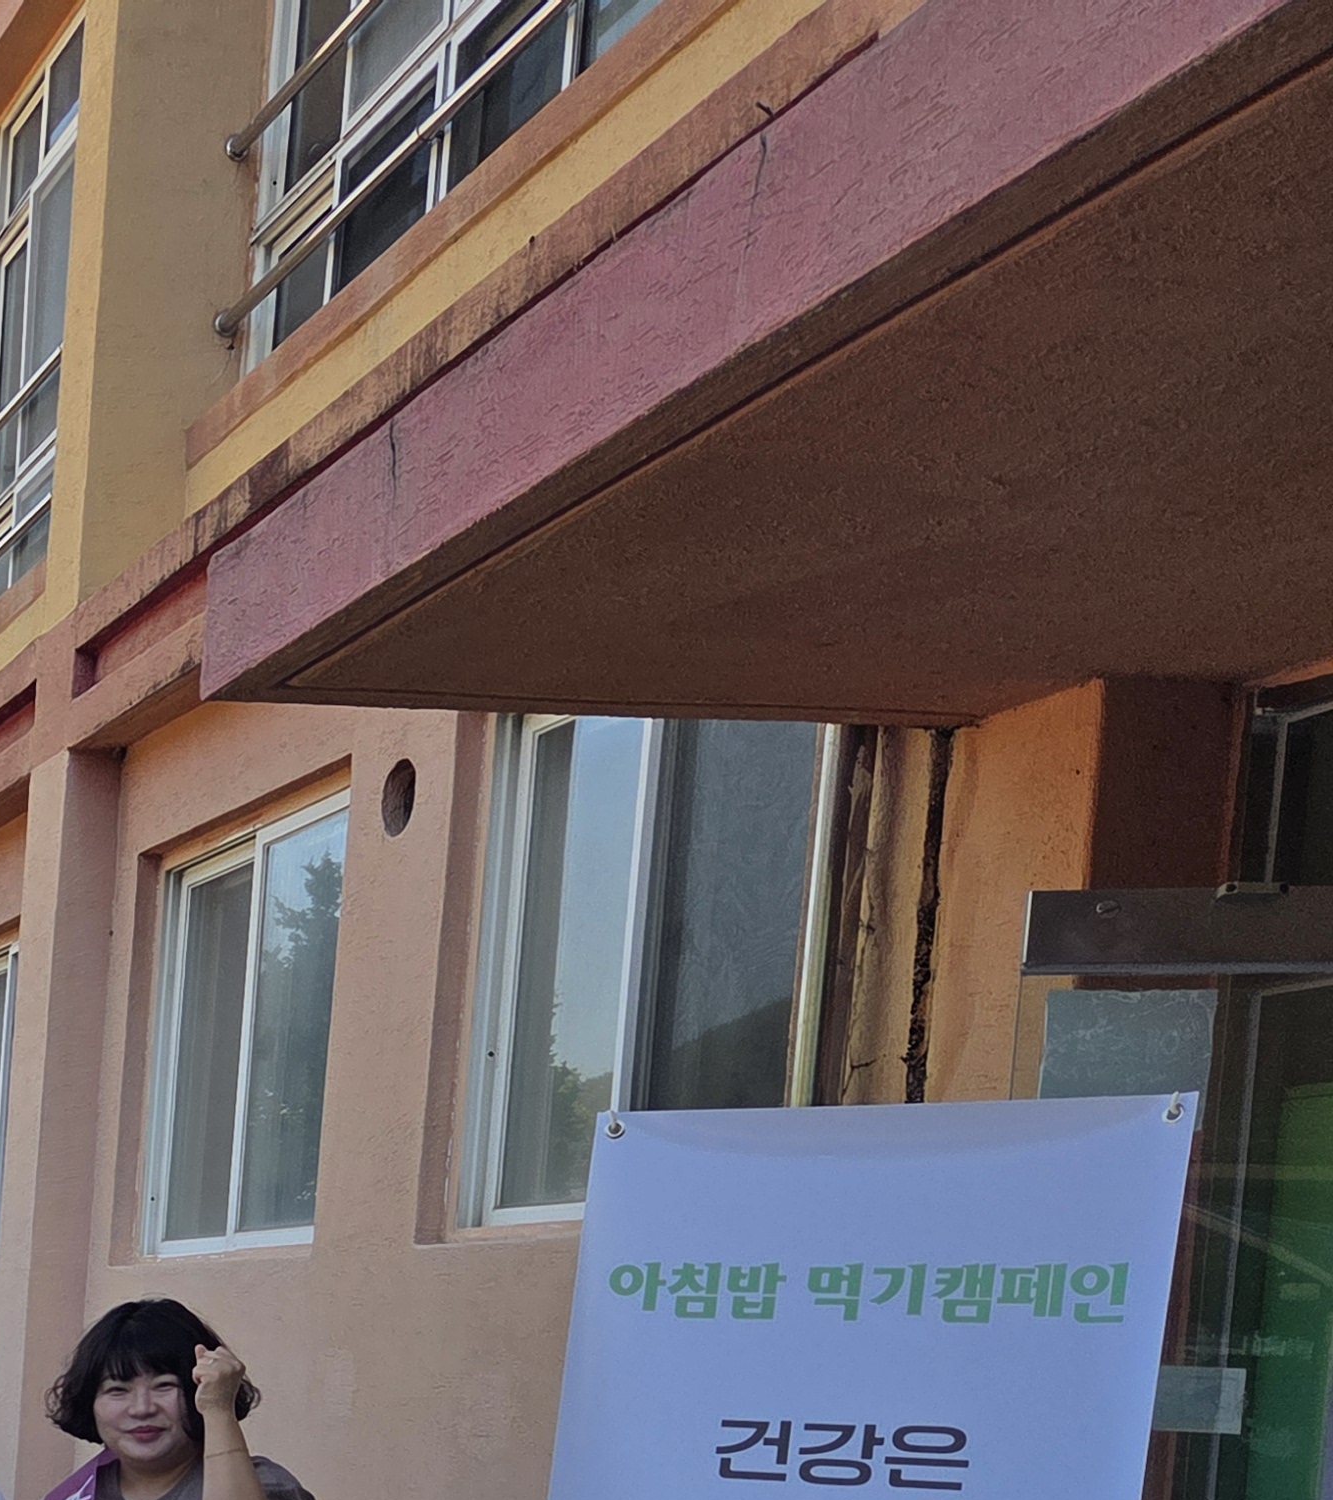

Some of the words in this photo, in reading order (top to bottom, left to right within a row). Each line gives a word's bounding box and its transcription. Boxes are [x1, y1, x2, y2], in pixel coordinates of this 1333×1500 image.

[609, 1260, 787, 1321] 아침밥
[808, 1261, 1130, 1325] 먹기캠페인
[714, 1418, 972, 1491] 건강은
